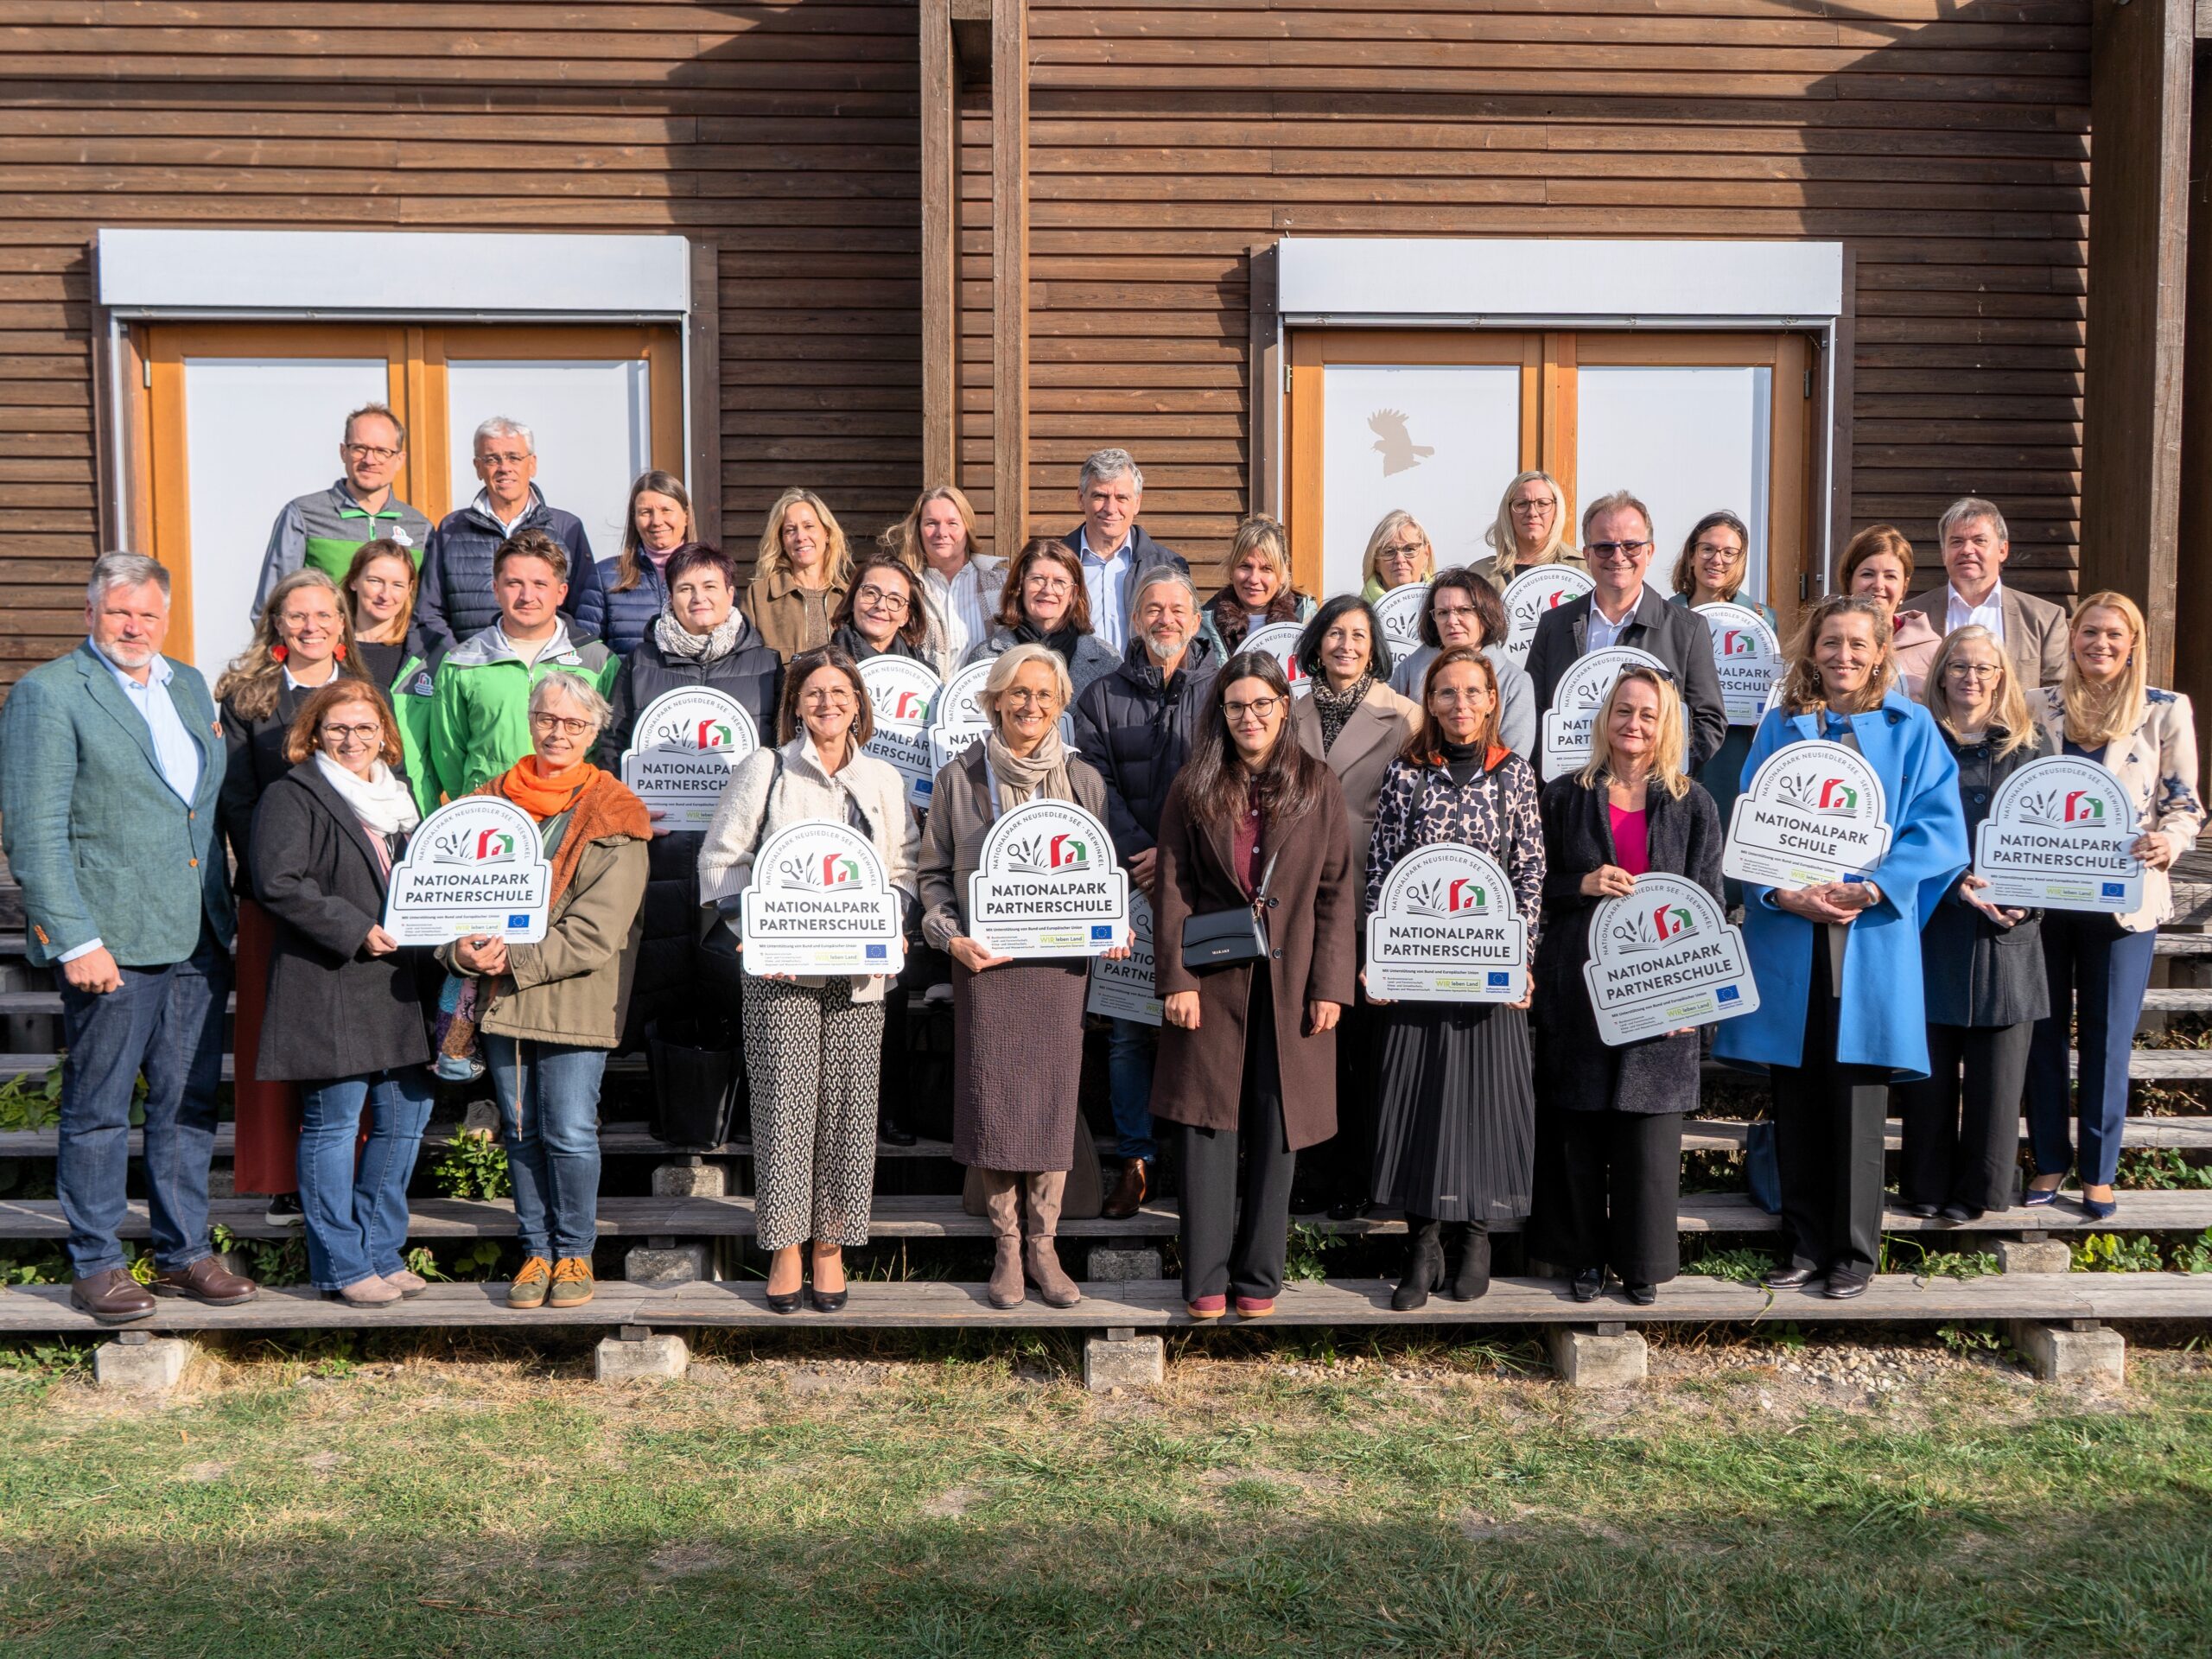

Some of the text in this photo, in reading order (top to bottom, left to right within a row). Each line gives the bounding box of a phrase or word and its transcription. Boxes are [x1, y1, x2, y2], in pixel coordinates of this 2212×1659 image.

[1522, 575, 1560, 589] NEUSIEDLER
[1564, 657, 1633, 708] NATIONALPARK NEUSIEDLER
[949, 678, 973, 721] NATIONALPARK
[644, 697, 747, 751] NATIONALPARK NEUSIEDLER SEE SEEWINKEL
[873, 727, 929, 752] ONALPAR
[861, 741, 931, 768] NERSCHUL
[643, 763, 737, 775] NATIONALPA
[637, 779, 728, 791] PARTNERSCH
[1762, 752, 1872, 819] NATIONALPARK NEUSIEDLER SEE SEEWINKEL
[2003, 767, 2121, 826] NATIONALPARK NEUSIEDLER SEE SEEWINKEL
[418, 807, 531, 861] NATIONALPARK NEUSIEDLER SEE SEEWINKEL
[1755, 810, 1869, 845] NATIONALPARK
[993, 820, 1022, 869] NATIONALPARK
[1022, 811, 1068, 823] NEUSIEDLER
[1068, 817, 1082, 828] SEE
[1084, 829, 1103, 868] SEEWINKEL
[1779, 834, 1838, 856] SCHULE
[2000, 834, 2122, 852] NATIONALPARK
[766, 830, 876, 887] NATIONALPARK NEUSIEDLER SEE SEEWINKEL
[1993, 850, 2127, 870] PARTNERSCHULE
[413, 874, 530, 887] NATIONALPARK
[992, 882, 1107, 897] NATIONALPARK
[1391, 863, 1422, 911] NATIONALPARK
[1423, 855, 1468, 866] NEUSIEDLER
[1468, 861, 1483, 873] SEE
[1484, 874, 1503, 913] SEEWINKEL
[405, 890, 534, 903] PARTNERSCHULE
[765, 901, 880, 913] NATIONALPARK
[987, 899, 1112, 914] PARTNERSCHULE
[760, 918, 887, 931] PARTNERSCHULE
[1389, 926, 1505, 940] NATIONALPARK
[1601, 903, 1622, 956] NATIONALPARK
[1665, 887, 1680, 895] SEE
[1685, 894, 1713, 930] SEEWINKEL
[1383, 944, 1510, 958] PARTNERSCHULE
[1606, 943, 1723, 982] NATIONALPARK
[1605, 959, 1733, 1001] PARTNERSCHULE
[1667, 1008, 1683, 1018] WIR
